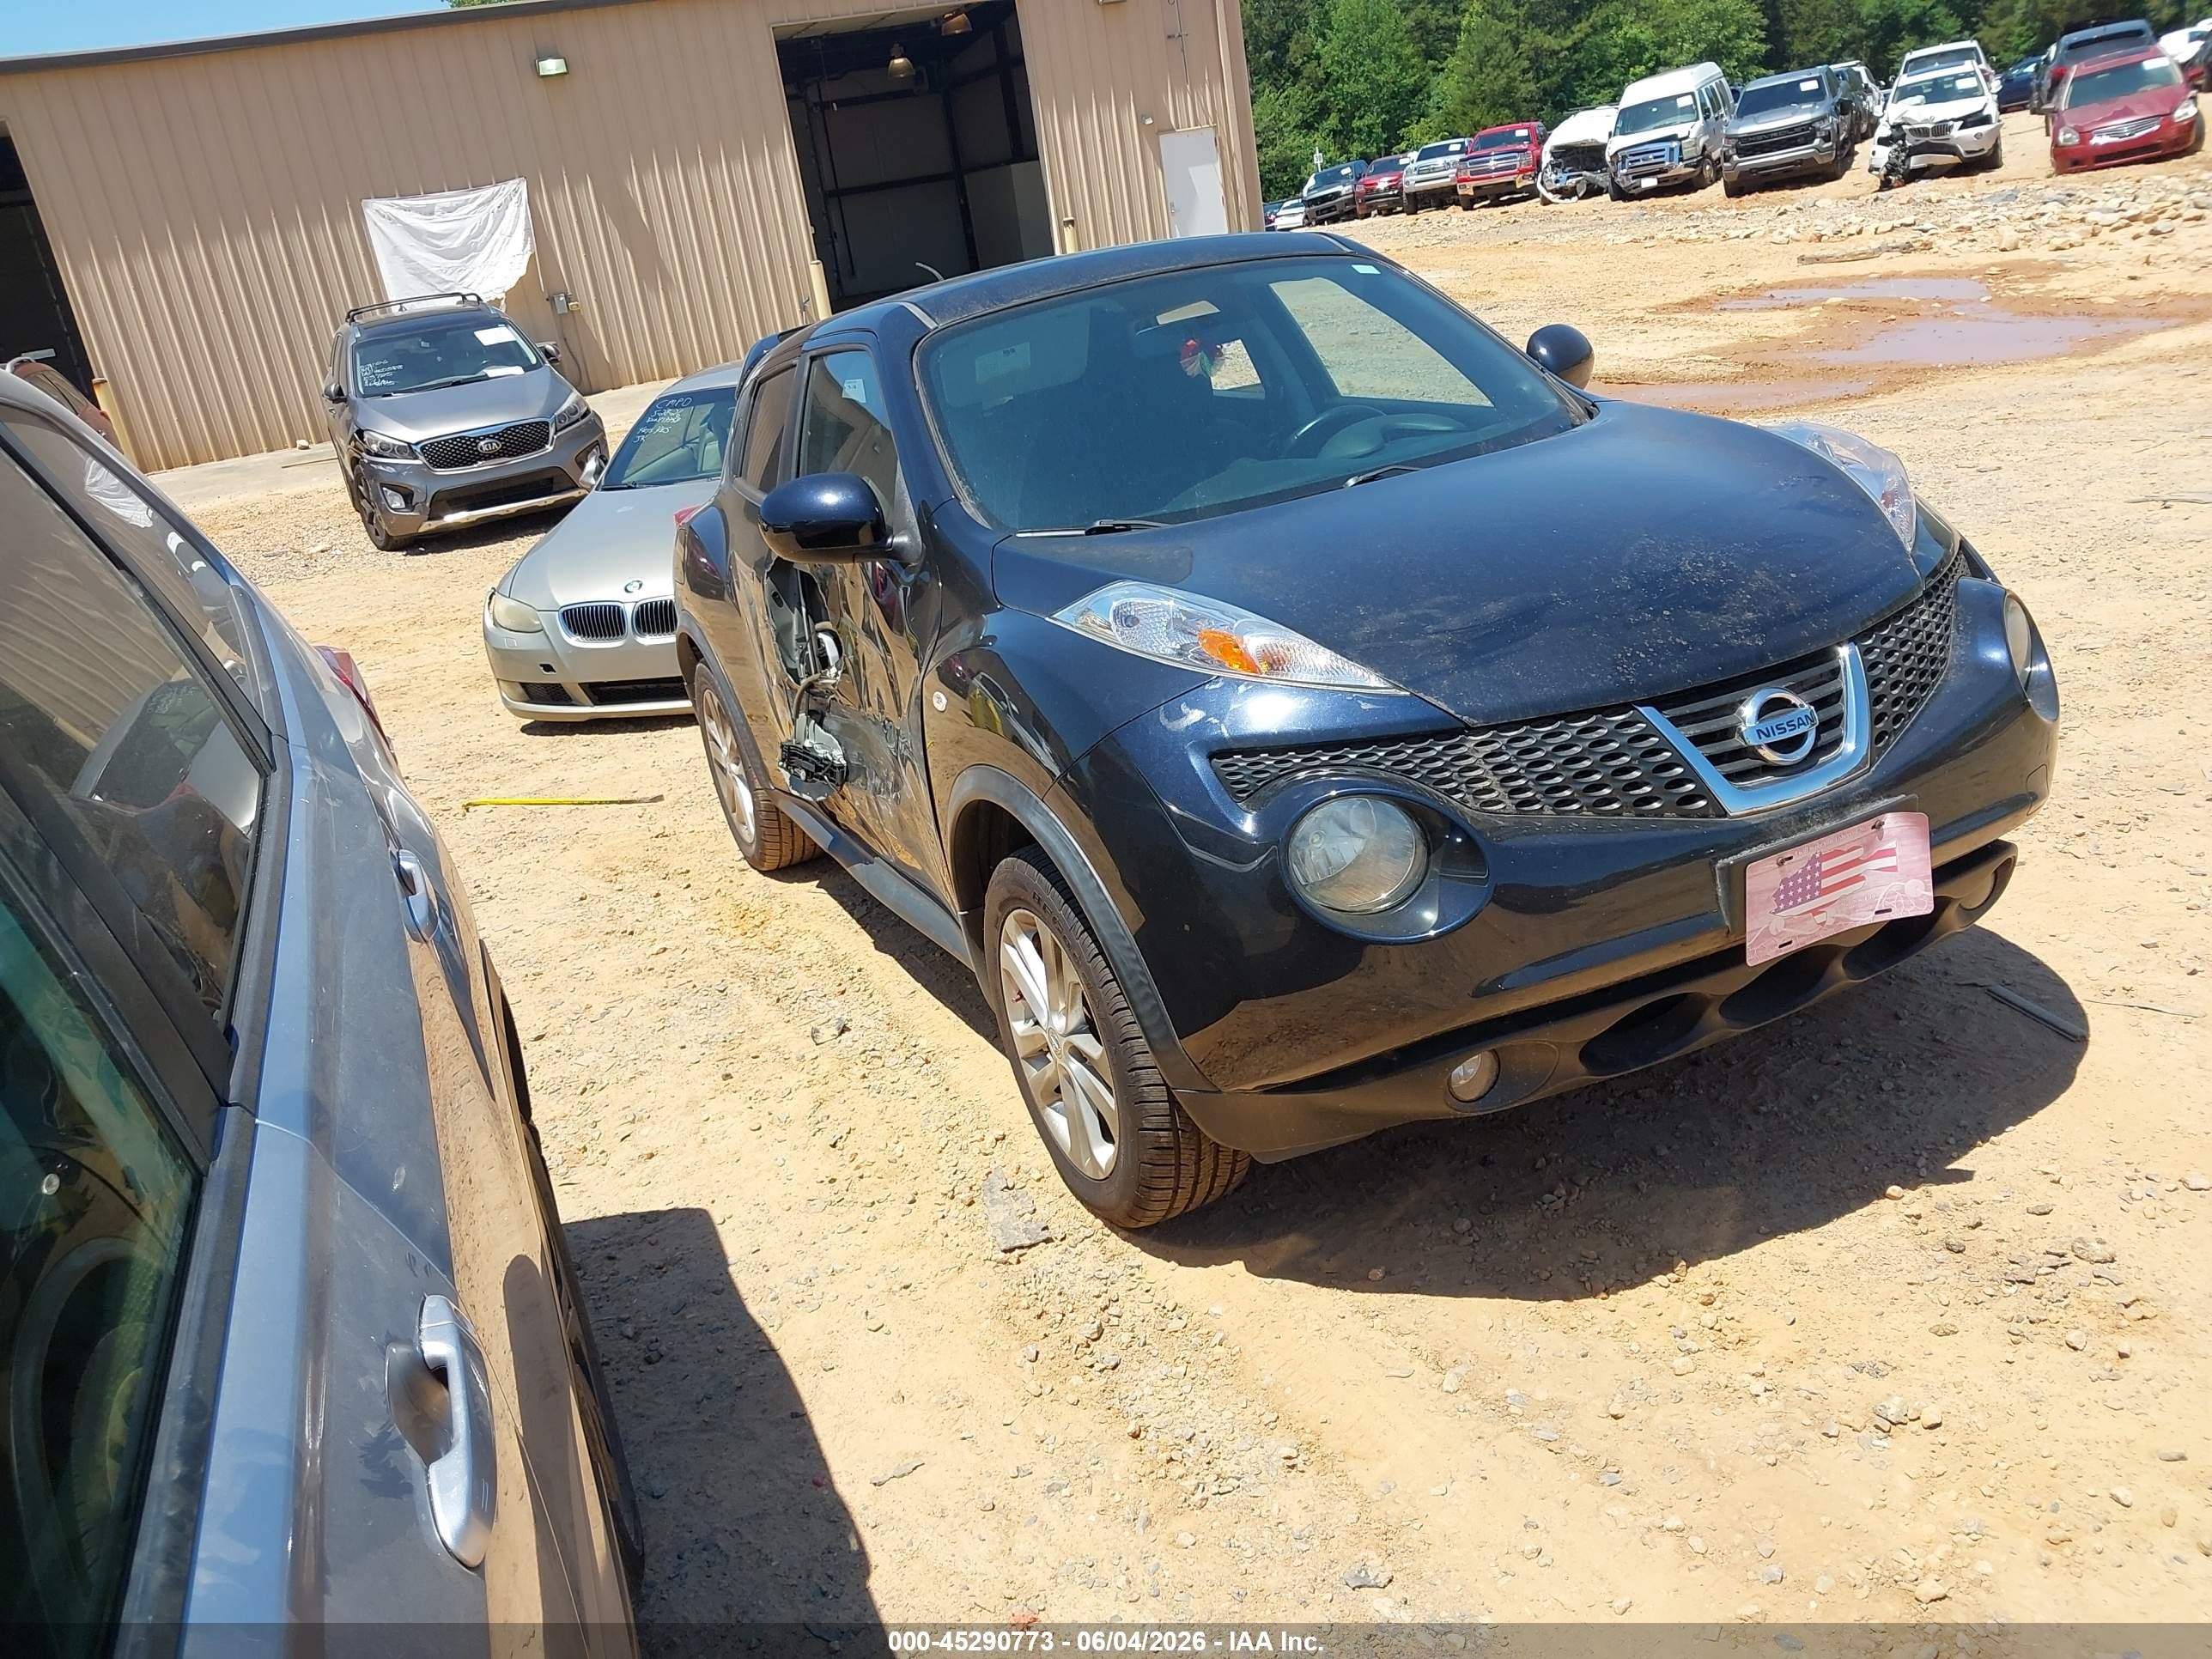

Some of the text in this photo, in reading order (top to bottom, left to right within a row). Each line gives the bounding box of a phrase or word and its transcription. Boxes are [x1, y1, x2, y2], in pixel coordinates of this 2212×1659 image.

[655, 397, 693, 409] CMPD
[482, 442, 499, 452] KIA
[1756, 711, 1815, 740] NISSAN
